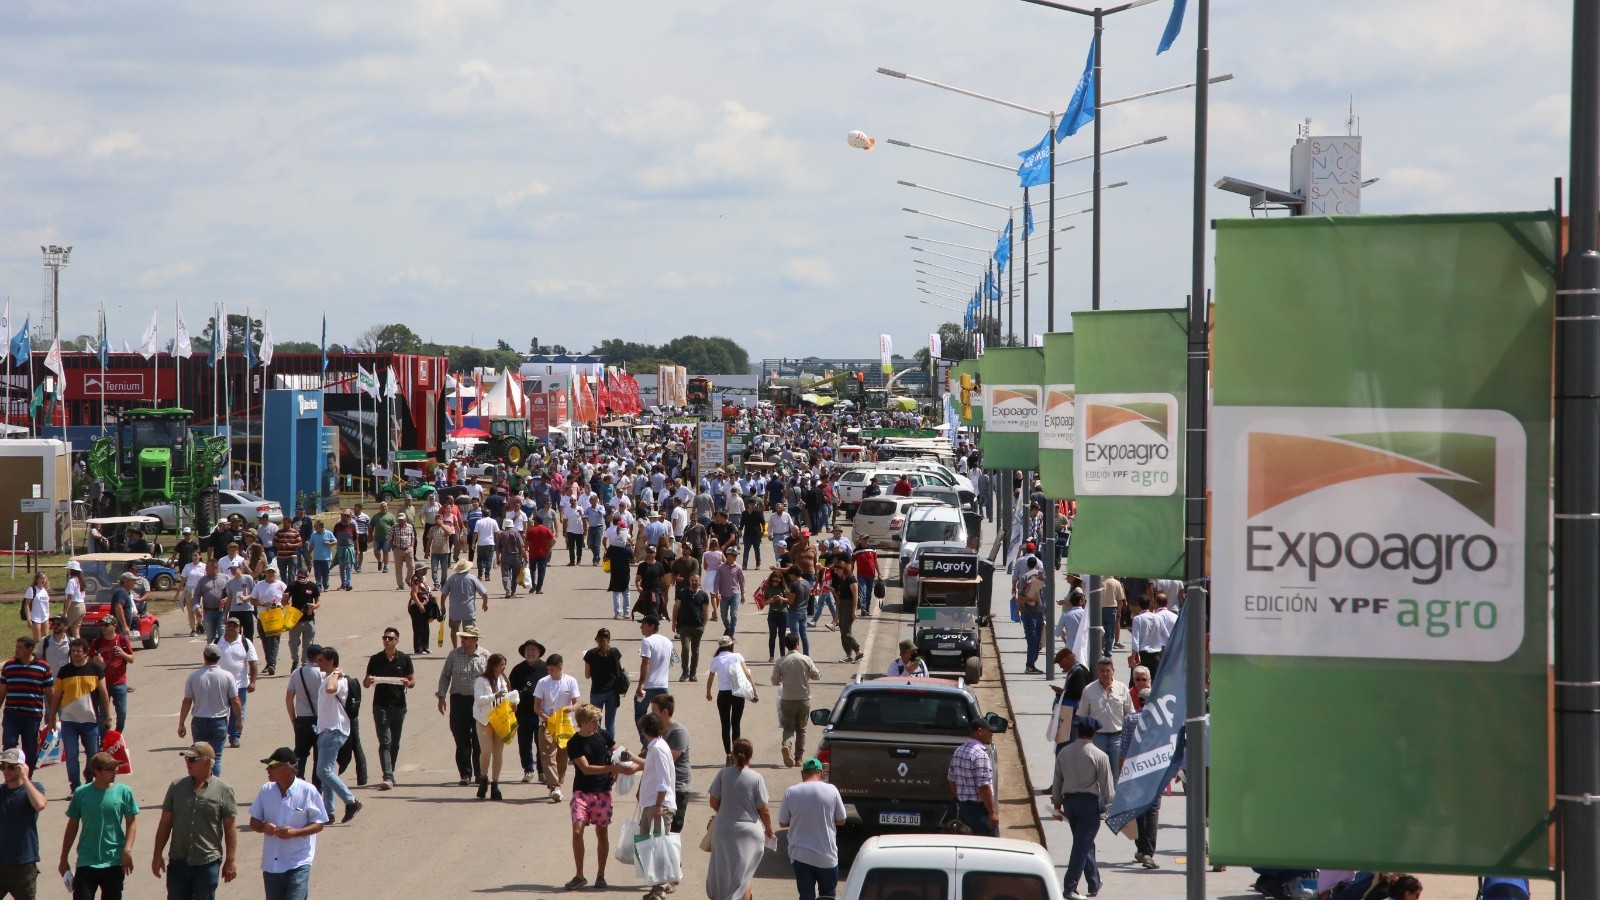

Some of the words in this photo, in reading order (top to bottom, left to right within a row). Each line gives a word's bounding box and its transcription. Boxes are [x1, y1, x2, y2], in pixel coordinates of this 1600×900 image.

[1312, 142, 1360, 155] SAN
[1311, 186, 1359, 200] SAN
[1311, 201, 1358, 215] NCO
[105, 381, 140, 391] Ternium
[992, 406, 1038, 418] Expoagro
[1019, 420, 1038, 428] agro
[1086, 443, 1169, 465] Expoagro
[1085, 470, 1111, 479] EDICIÓN
[1131, 470, 1169, 487] agro
[1246, 525, 1498, 585] Expoagro
[935, 561, 972, 573] Agrofy
[1245, 593, 1317, 613] EDICIÓN
[1328, 597, 1389, 614] YPF
[1397, 598, 1497, 638] agro
[935, 633, 968, 643] Agrofy
[881, 815, 890, 823] AE
